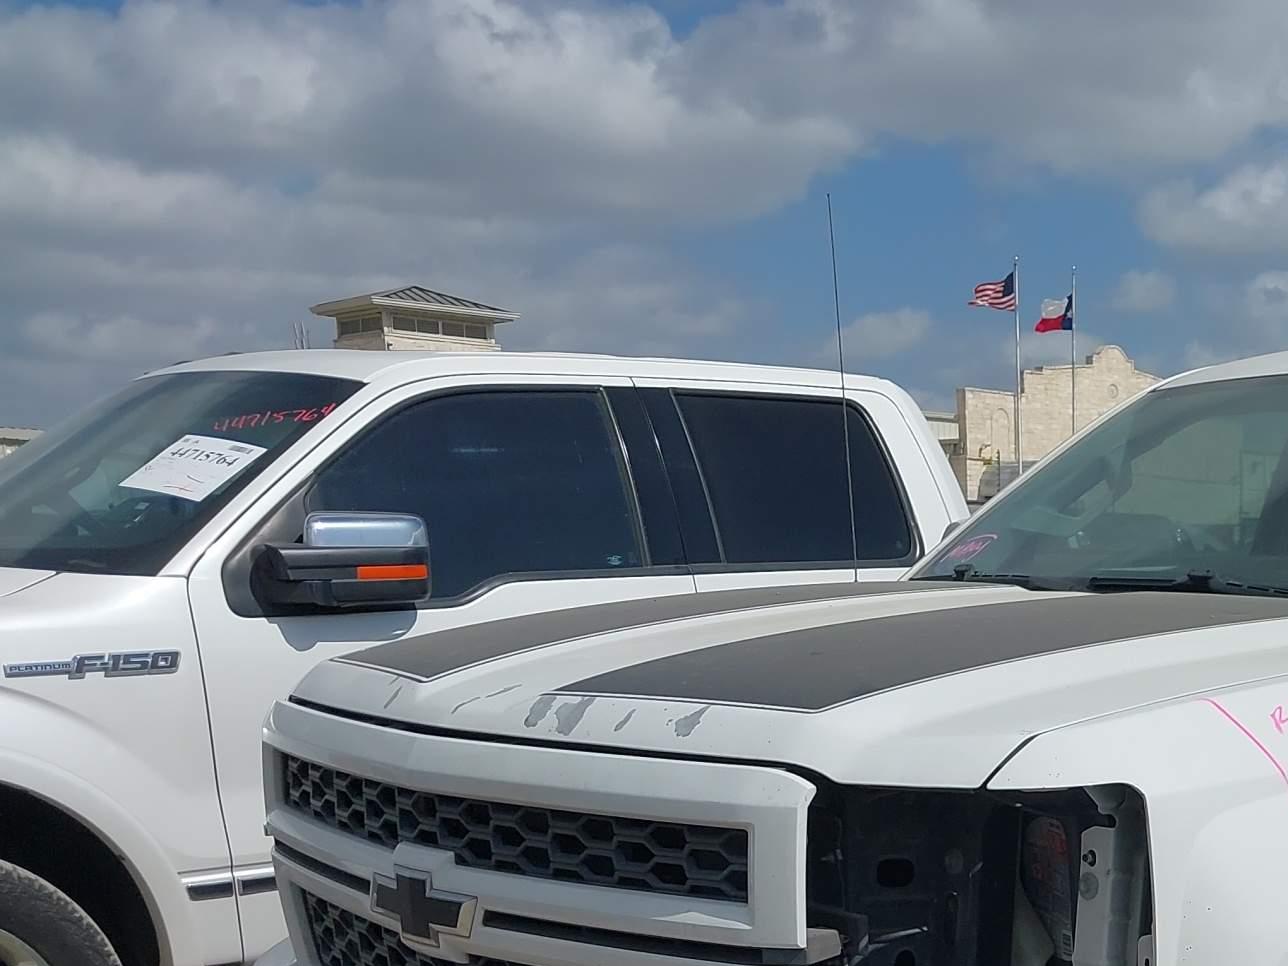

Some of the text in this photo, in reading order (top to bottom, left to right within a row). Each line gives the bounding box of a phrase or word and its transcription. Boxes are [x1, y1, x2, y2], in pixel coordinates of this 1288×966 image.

[169, 446, 241, 467] 44715764
[8, 650, 181, 679] PLATINUM F-150
